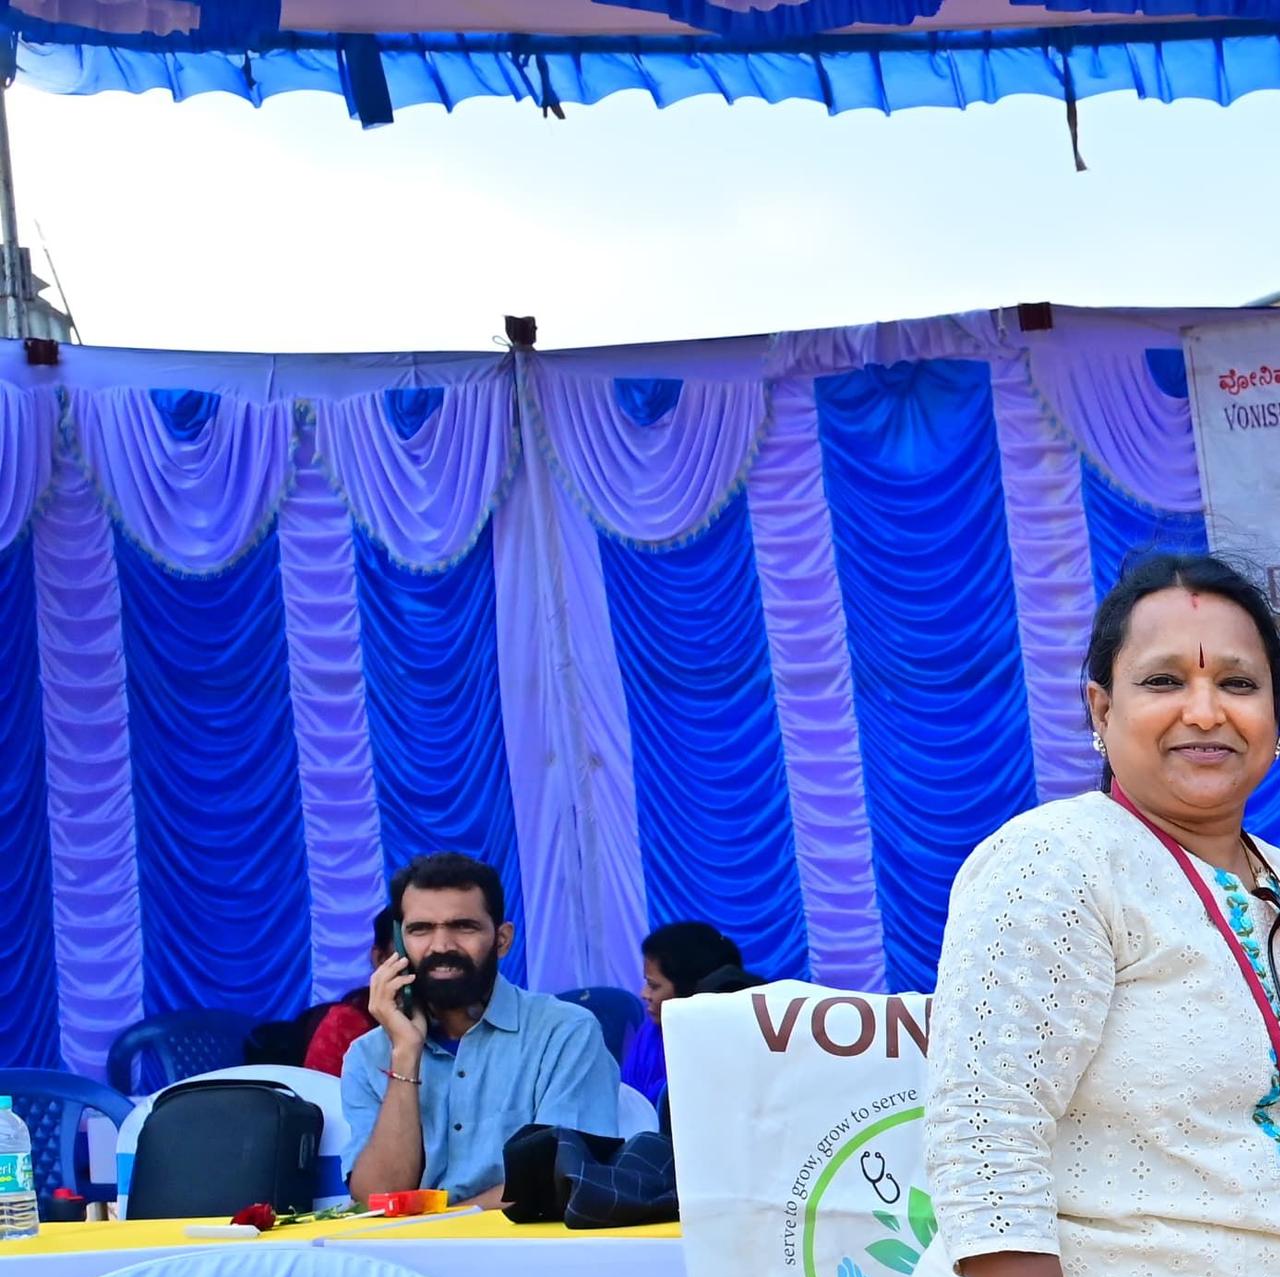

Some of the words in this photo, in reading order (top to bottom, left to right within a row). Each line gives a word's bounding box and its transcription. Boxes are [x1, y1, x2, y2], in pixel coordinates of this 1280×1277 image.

[751, 993, 933, 1059] VON
[851, 1106, 870, 1123] to
[871, 1088, 918, 1114] serve
[816, 1118, 851, 1158] grow
[791, 1155, 822, 1200] grow,
[783, 1200, 798, 1217] to
[783, 1220, 797, 1266] serve
